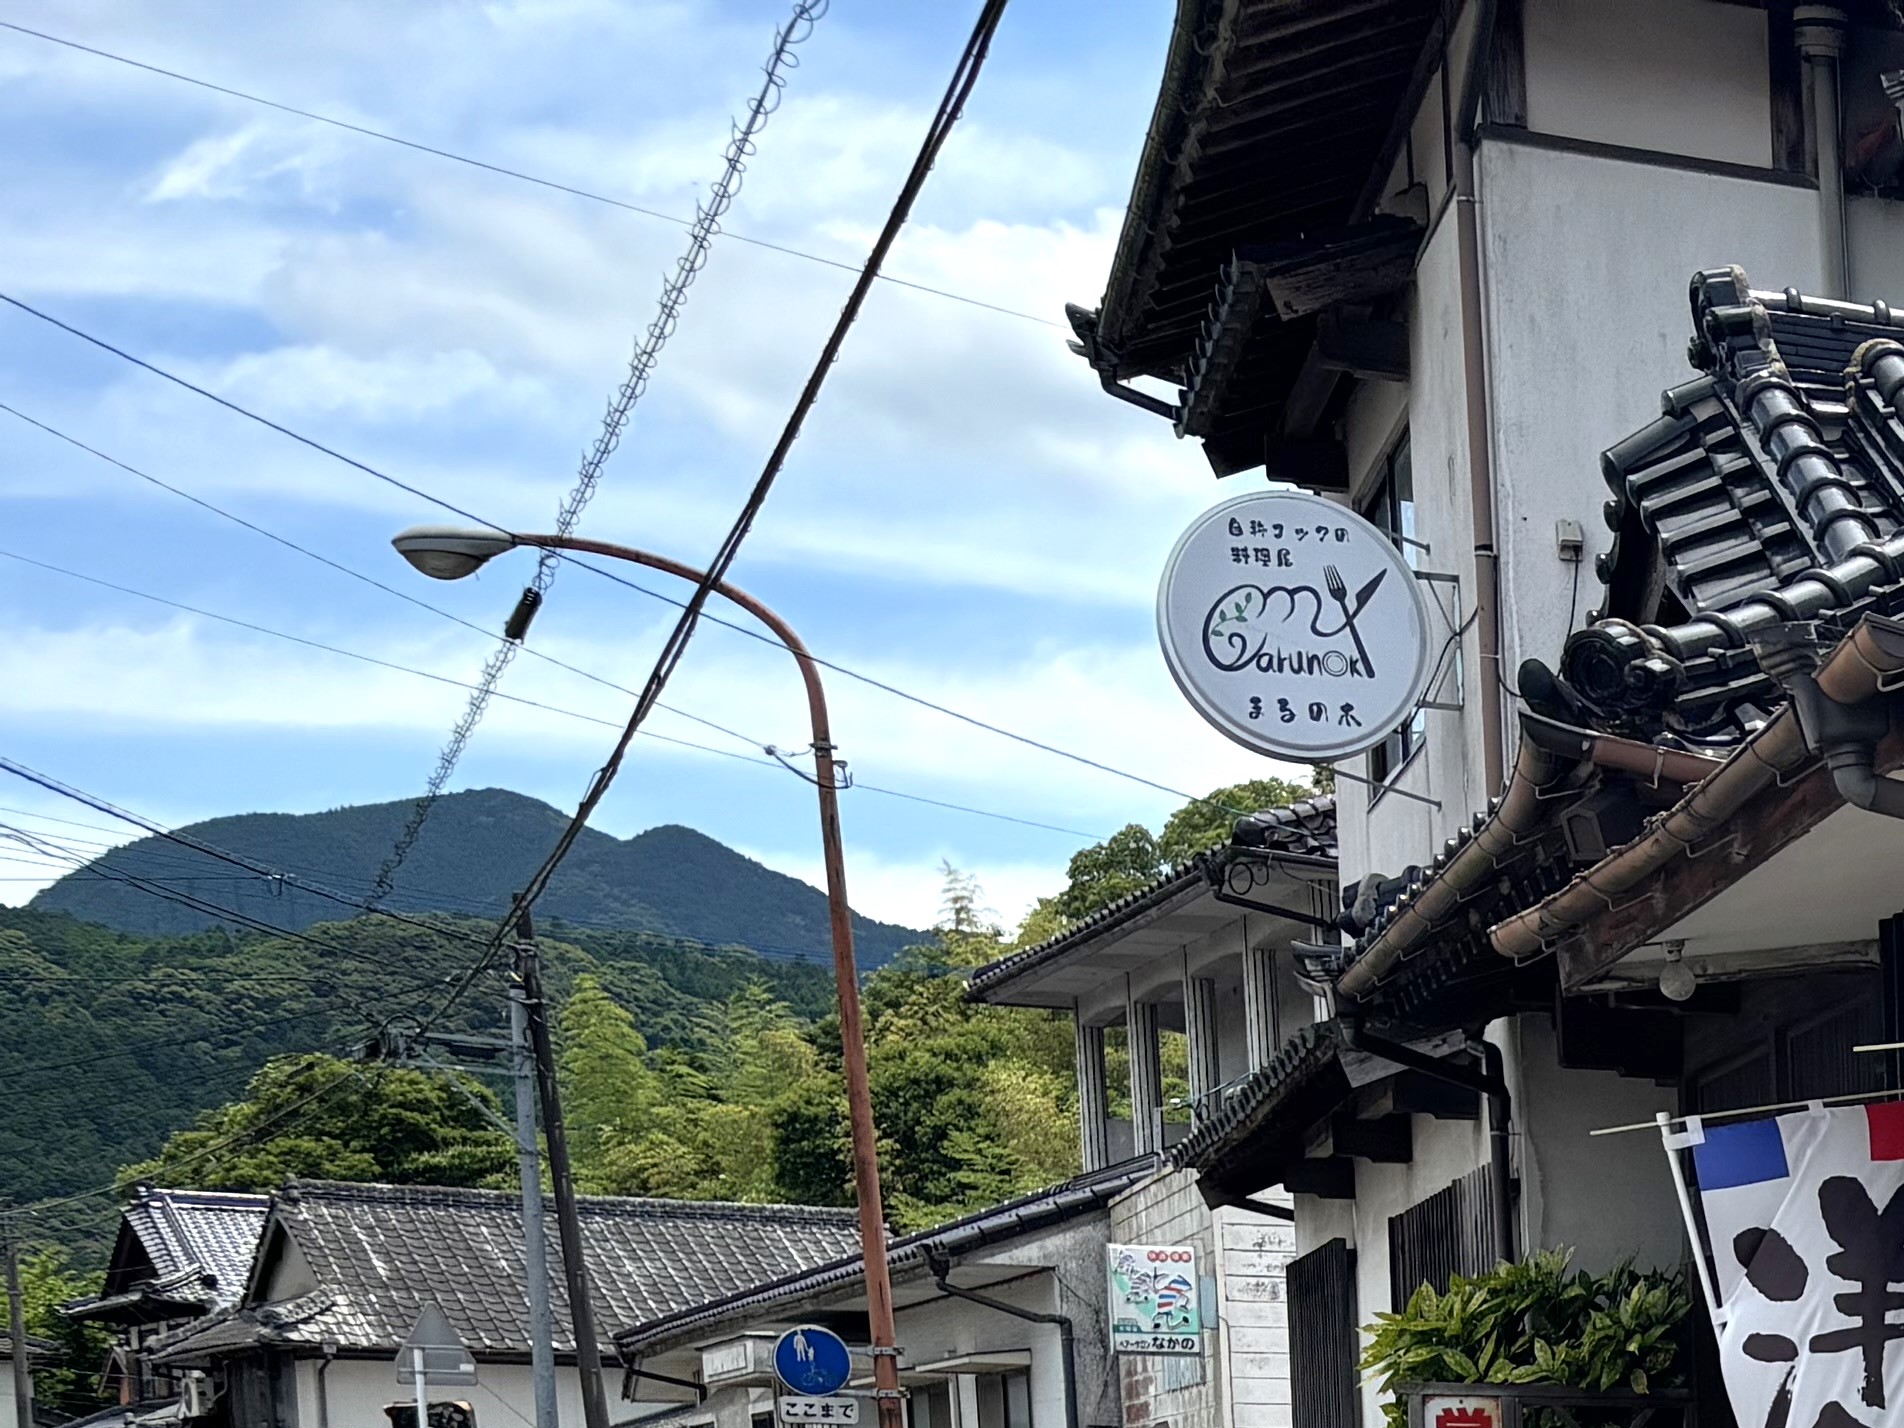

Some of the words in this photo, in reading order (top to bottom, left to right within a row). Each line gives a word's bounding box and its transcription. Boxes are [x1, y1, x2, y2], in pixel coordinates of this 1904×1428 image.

[1249, 696, 1362, 728] まるの木
[1152, 1335, 1196, 1351] なかの
[785, 1402, 854, 1419] ここまで
